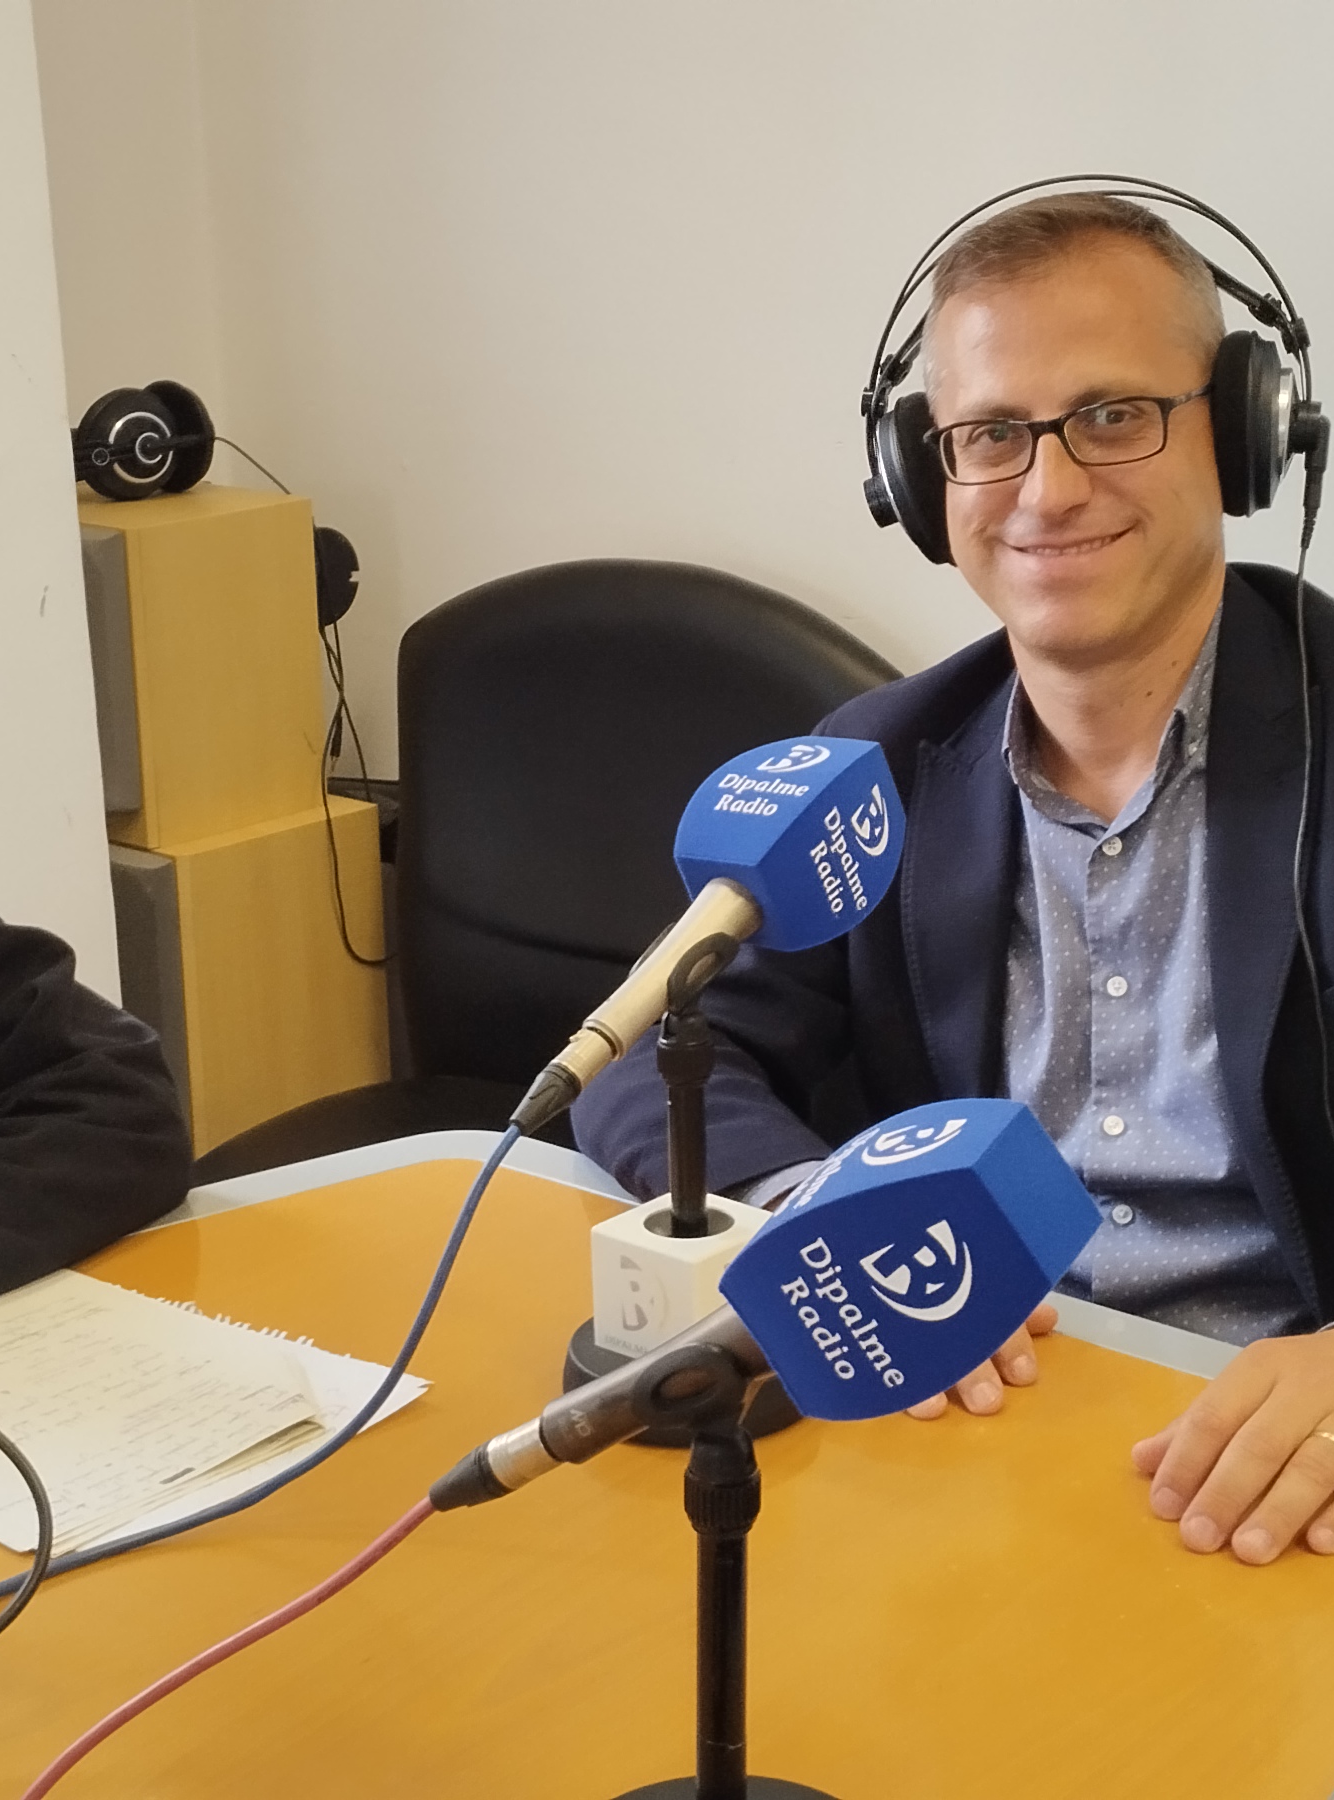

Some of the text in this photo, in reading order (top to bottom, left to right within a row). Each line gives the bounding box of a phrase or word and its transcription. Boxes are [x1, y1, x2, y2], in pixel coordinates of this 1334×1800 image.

[714, 793, 779, 817] Radio
[718, 773, 810, 797] Dipalme
[809, 839, 845, 914] Radio
[823, 805, 868, 911] Dipalme
[780, 1275, 856, 1381] Radio
[799, 1236, 906, 1389] Dipalme
